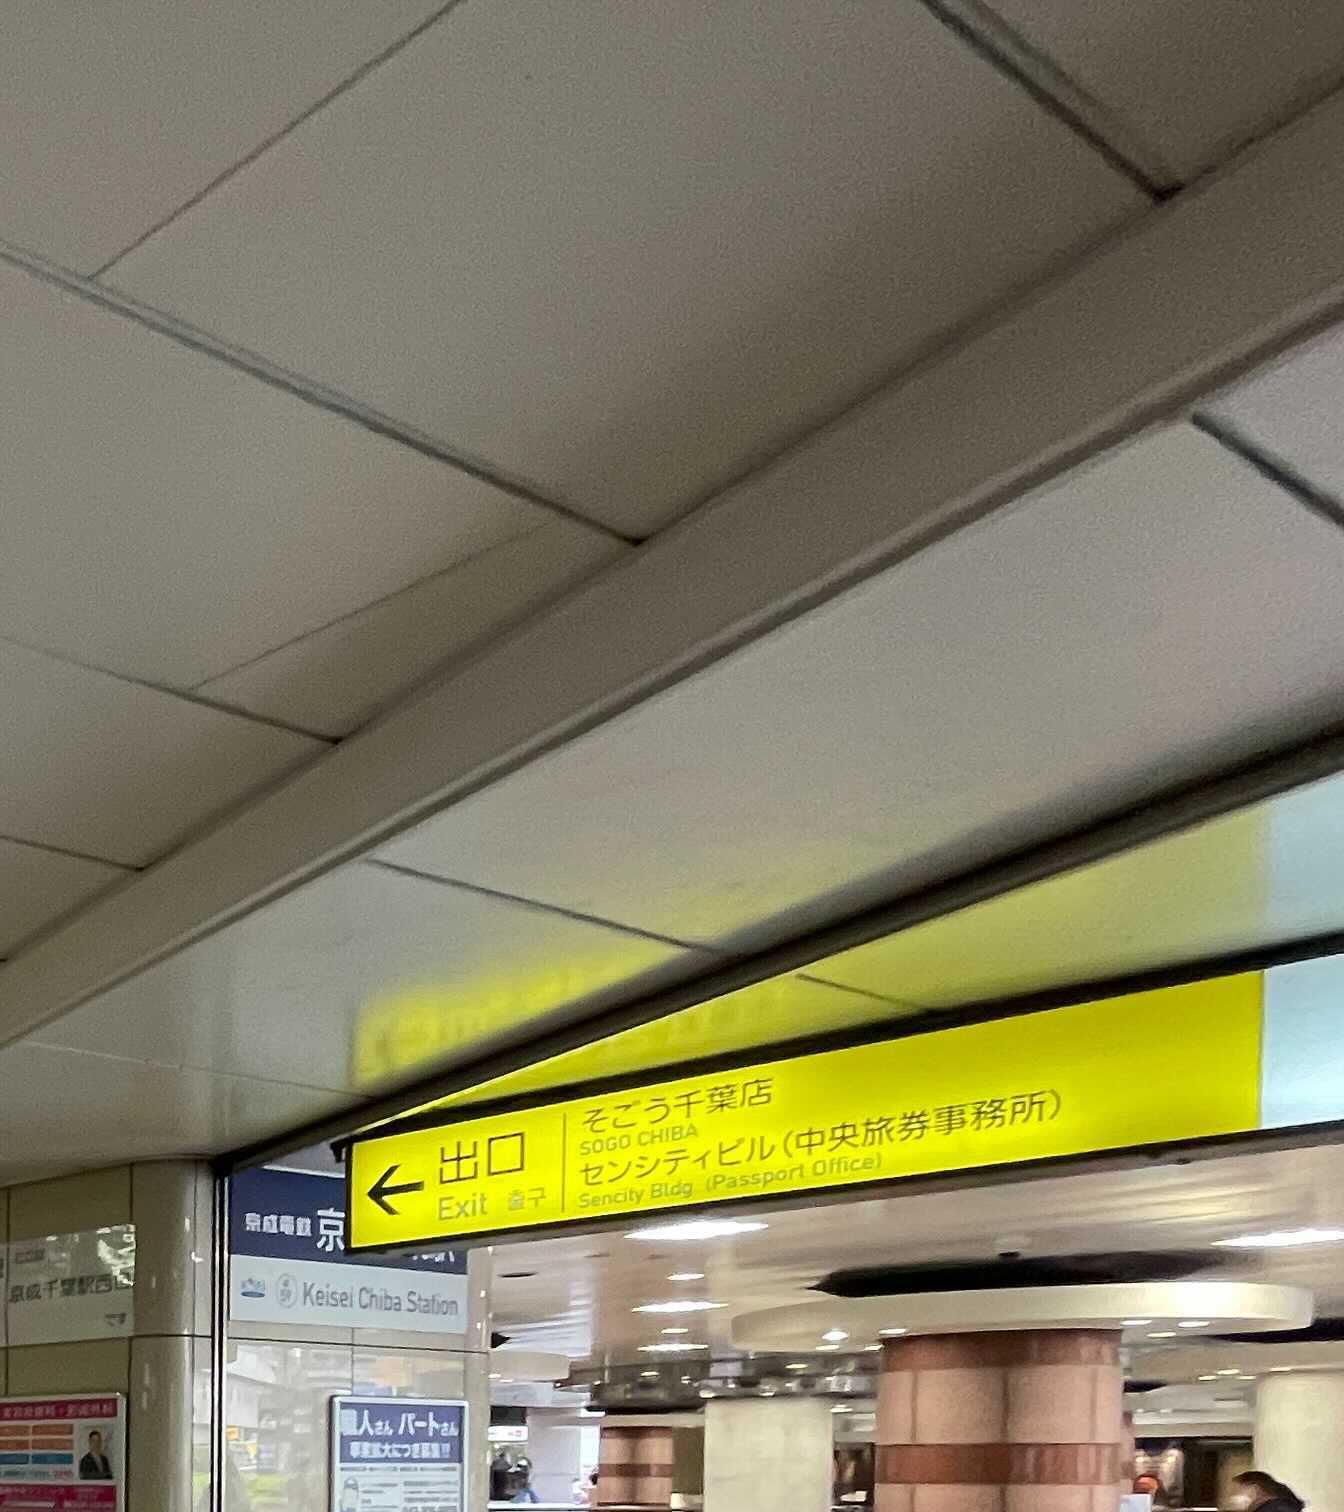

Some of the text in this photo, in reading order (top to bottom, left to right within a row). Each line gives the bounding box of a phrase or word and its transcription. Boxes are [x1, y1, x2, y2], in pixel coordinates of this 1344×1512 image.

[582, 1076, 774, 1135] そごう千葉店
[579, 1123, 699, 1156] SOGO CHIBA
[439, 1130, 526, 1186] 出口
[579, 1152, 883, 1209] Sencity Bldg (Passport Office)
[244, 1211, 313, 1237] 京成電鉄
[438, 1191, 488, 1222] Exit
[302, 1281, 354, 1308] Keisei
[358, 1286, 402, 1312] Chiba
[406, 1290, 459, 1316] Station
